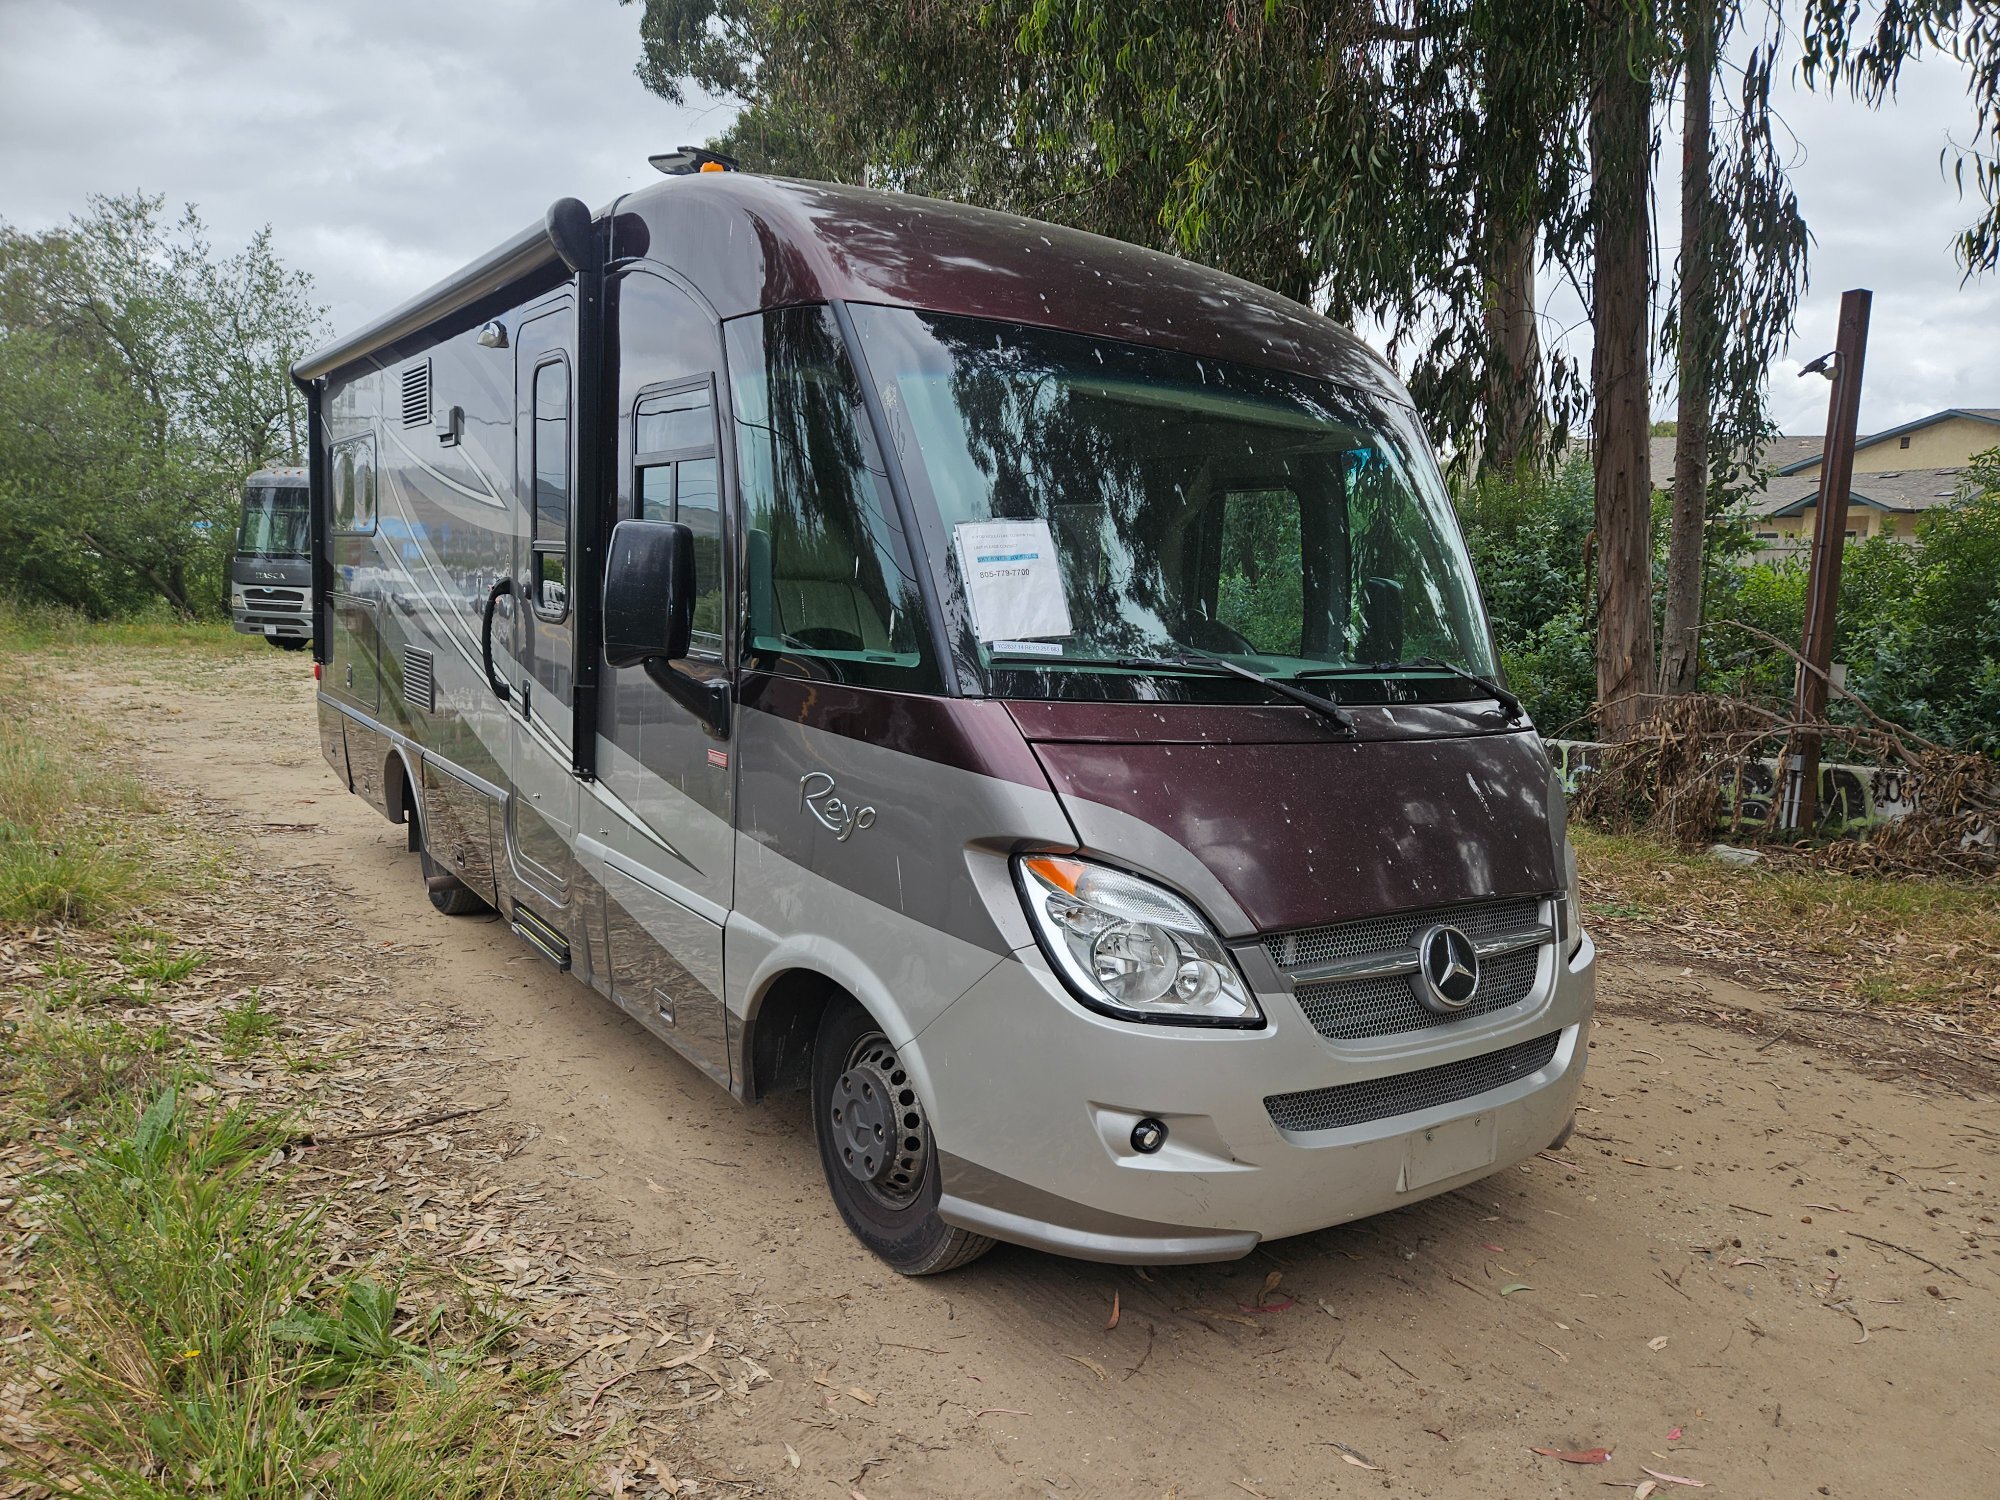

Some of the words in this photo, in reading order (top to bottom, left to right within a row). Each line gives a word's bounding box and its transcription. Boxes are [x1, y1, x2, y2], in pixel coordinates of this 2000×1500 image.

[255, 571, 287, 580] ITASCA
[979, 568, 1030, 579] 805-779-7700
[799, 771, 877, 843] Reyo
